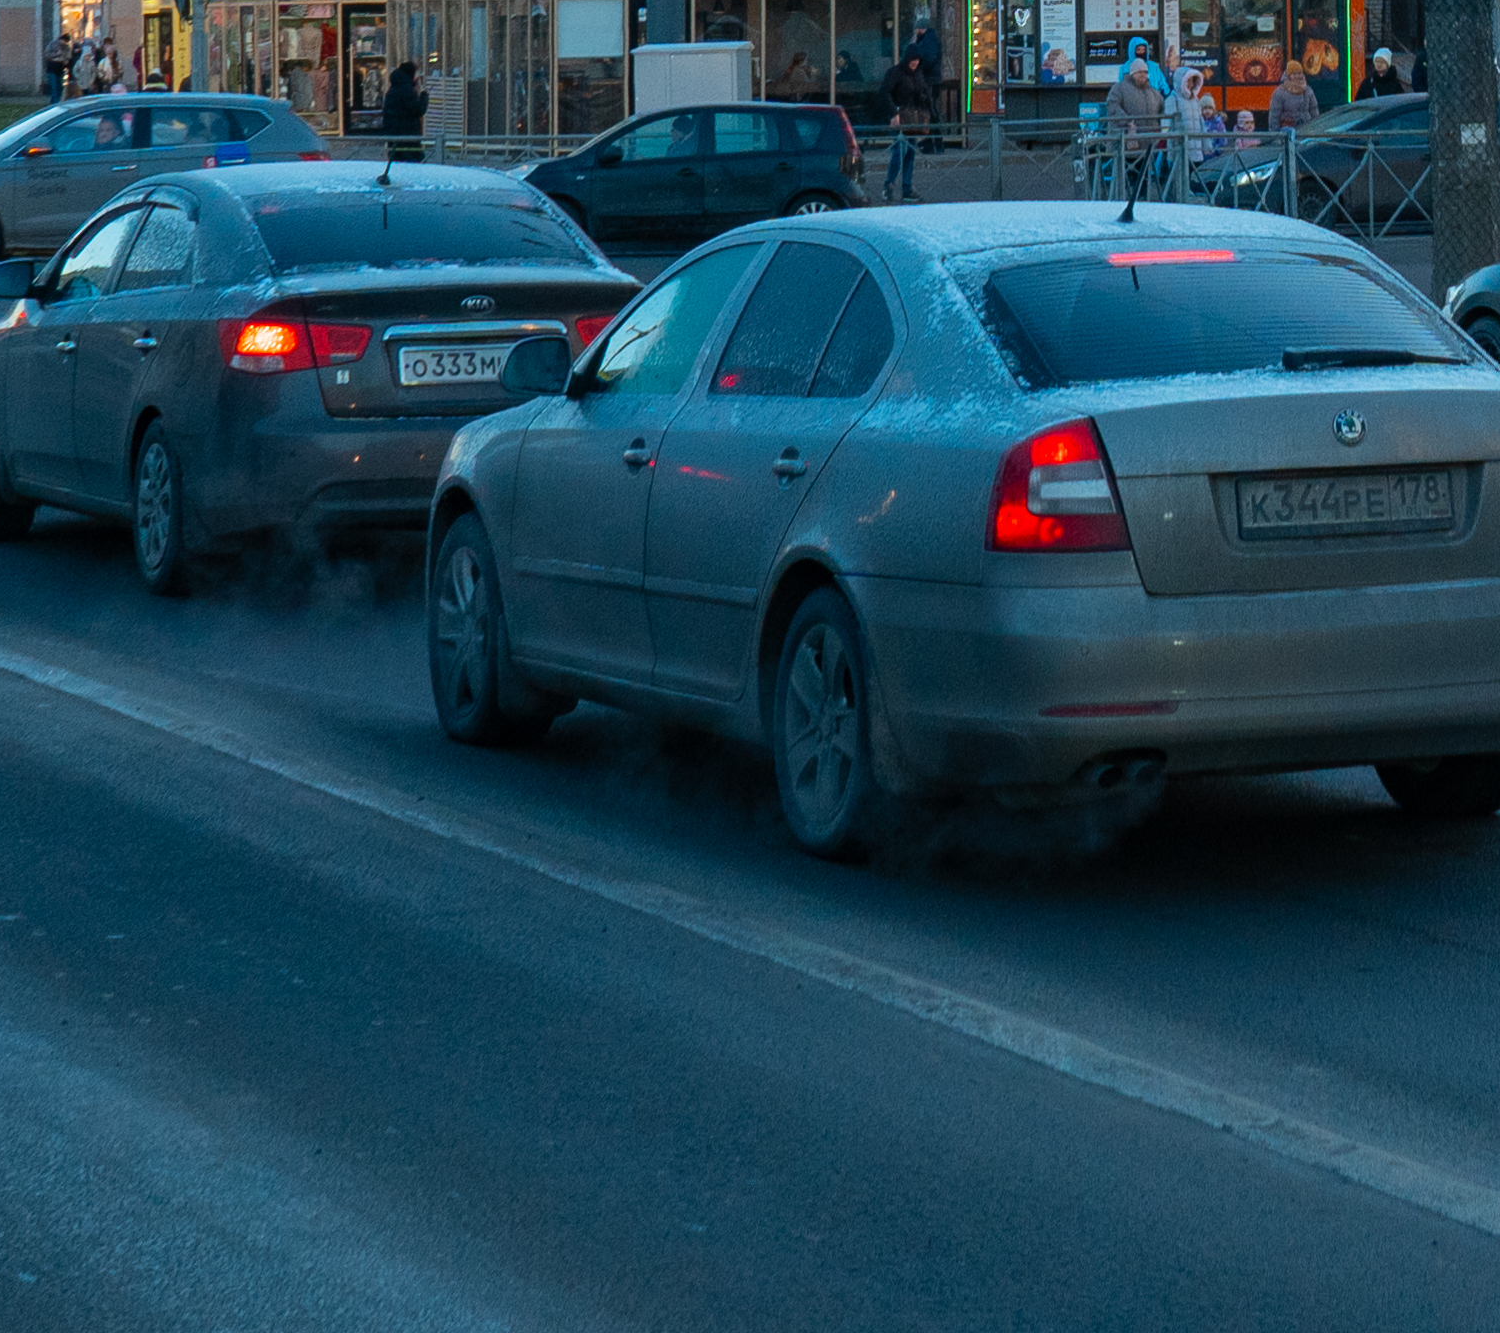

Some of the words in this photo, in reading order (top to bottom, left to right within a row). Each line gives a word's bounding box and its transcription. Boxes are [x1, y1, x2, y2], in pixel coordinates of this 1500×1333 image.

[465, 299, 489, 310] KIA
[412, 351, 501, 379] О333М
[1393, 475, 1441, 505] 178
